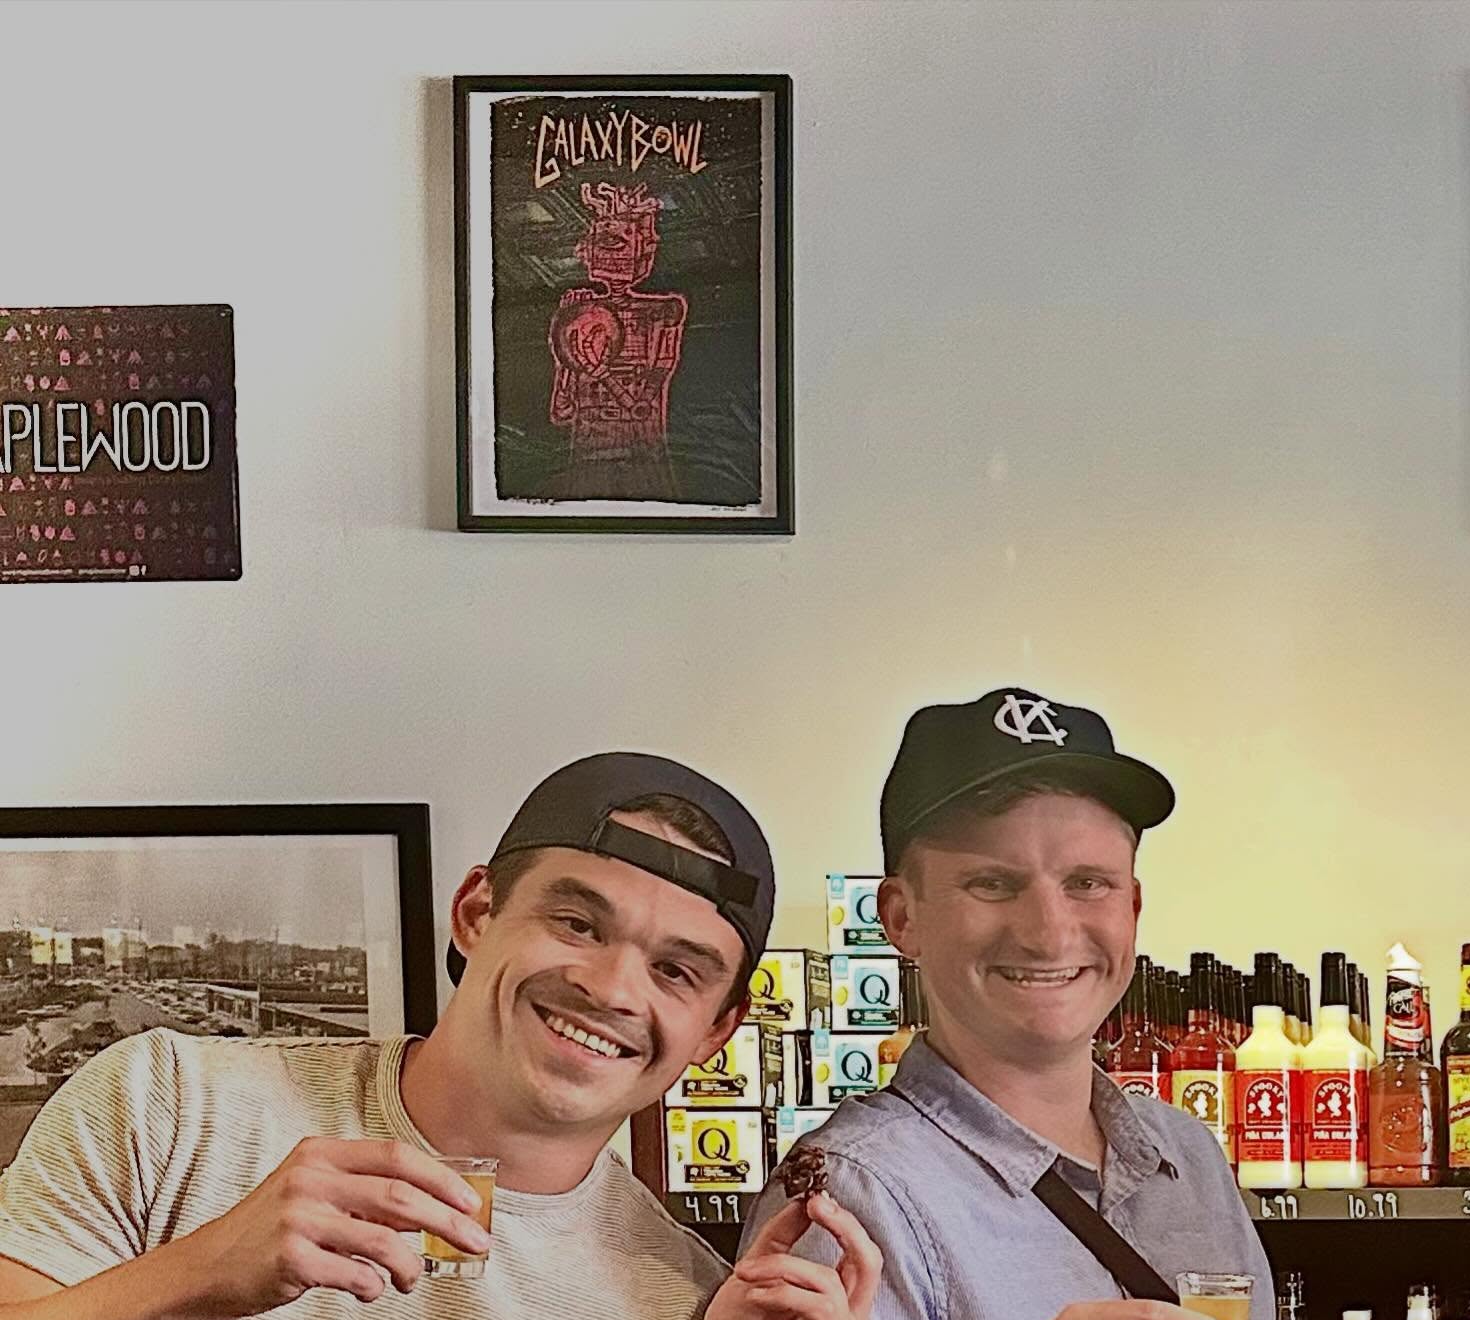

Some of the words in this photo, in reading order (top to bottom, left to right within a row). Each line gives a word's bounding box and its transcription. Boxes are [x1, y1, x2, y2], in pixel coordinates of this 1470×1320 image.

[0, 401, 210, 473] PLEWOOD
[748, 967, 776, 1001] Q
[860, 973, 891, 1007] Q
[841, 1050, 873, 1083] Q
[698, 1128, 732, 1162] Q
[685, 1195, 740, 1223] 4.99
[1261, 1195, 1298, 1219] 6.99
[1348, 1193, 1397, 1218] 10.99
